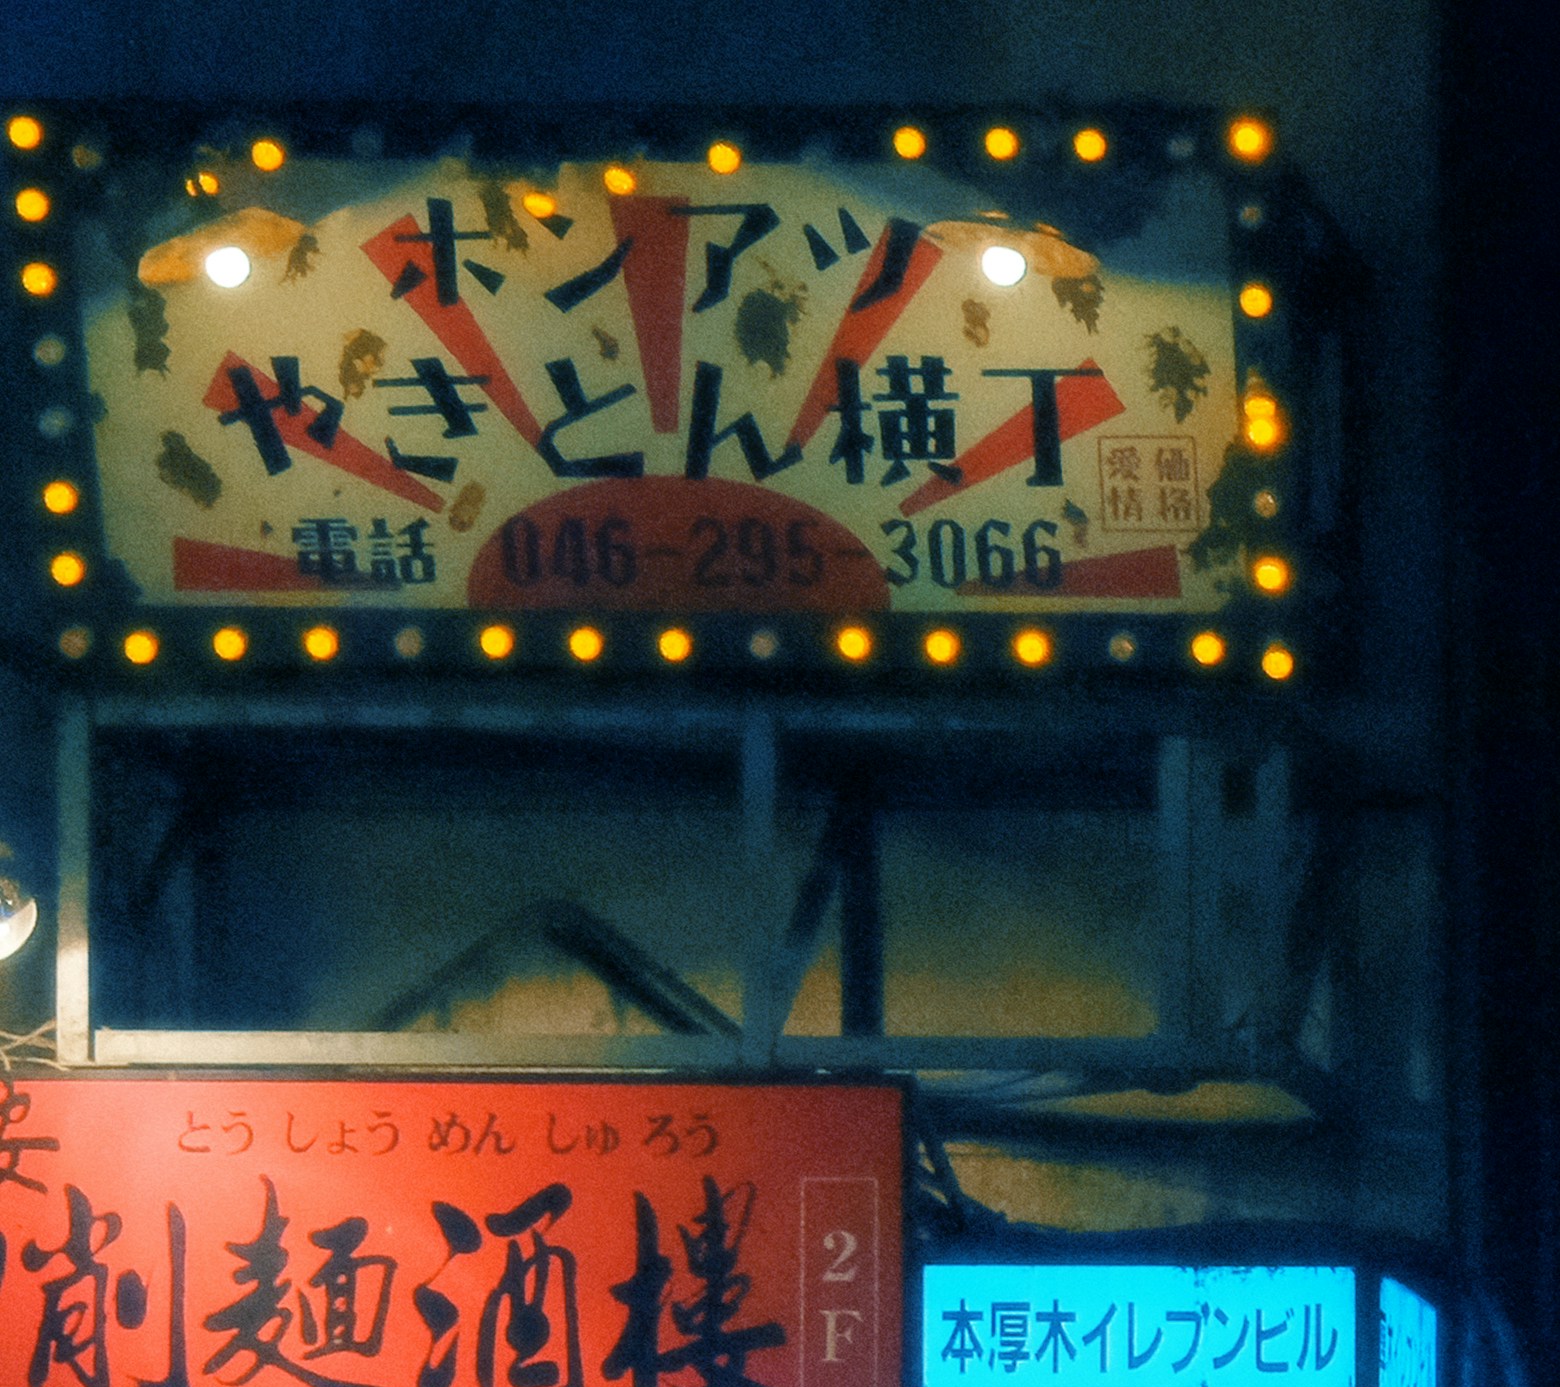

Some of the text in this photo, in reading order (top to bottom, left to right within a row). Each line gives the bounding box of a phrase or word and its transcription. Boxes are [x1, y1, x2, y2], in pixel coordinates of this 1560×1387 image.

[392, 197, 924, 314] ホンアツ
[217, 353, 1106, 486] やきとん横丁
[289, 516, 1064, 590] 電話 046-295-3066
[178, 1110, 720, 1156] とう しょう めん しゅ ろう
[820, 1229, 864, 1363] 2F
[940, 1298, 1340, 1375] 本厚木イレブンビル
